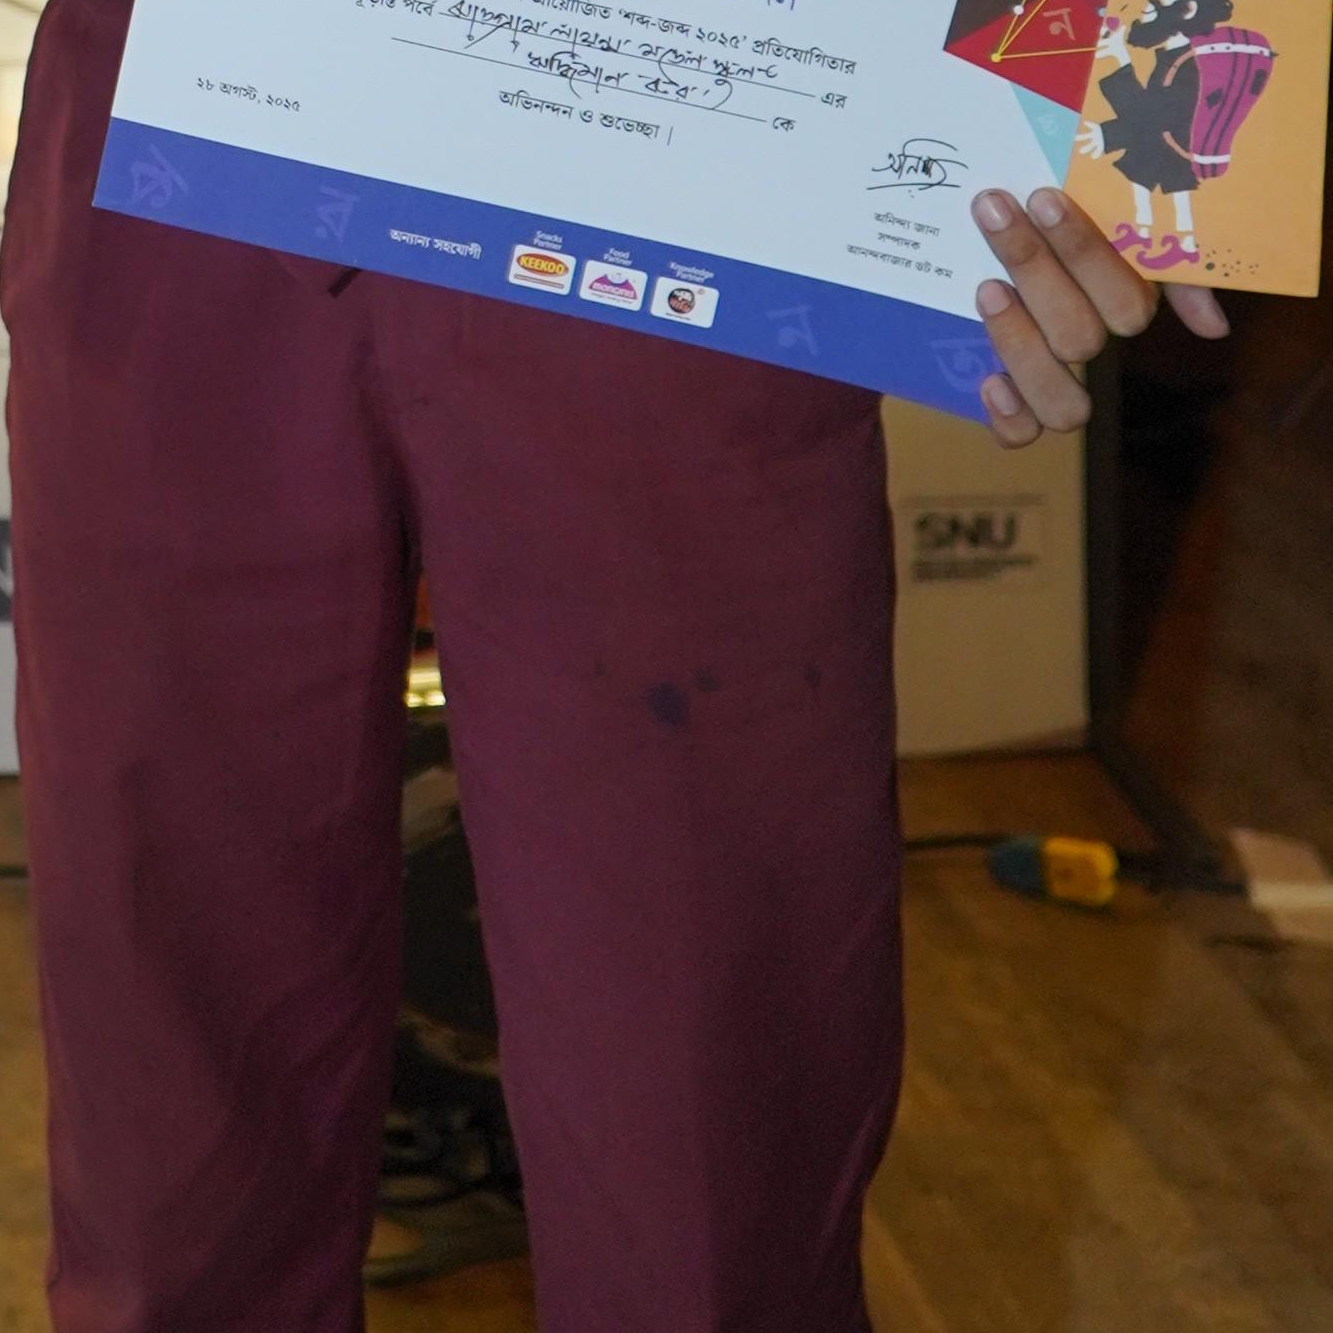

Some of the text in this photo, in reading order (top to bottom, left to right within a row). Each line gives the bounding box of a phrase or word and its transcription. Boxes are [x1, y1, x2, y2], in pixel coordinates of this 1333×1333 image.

[752, 36, 858, 75] প্রতিযোগিতার
[821, 91, 847, 109] এর
[499, 89, 661, 139] অভিনন্দন ও শুভেচ্ছা
[772, 116, 796, 133] কে
[519, 255, 566, 275] KEEKOO
